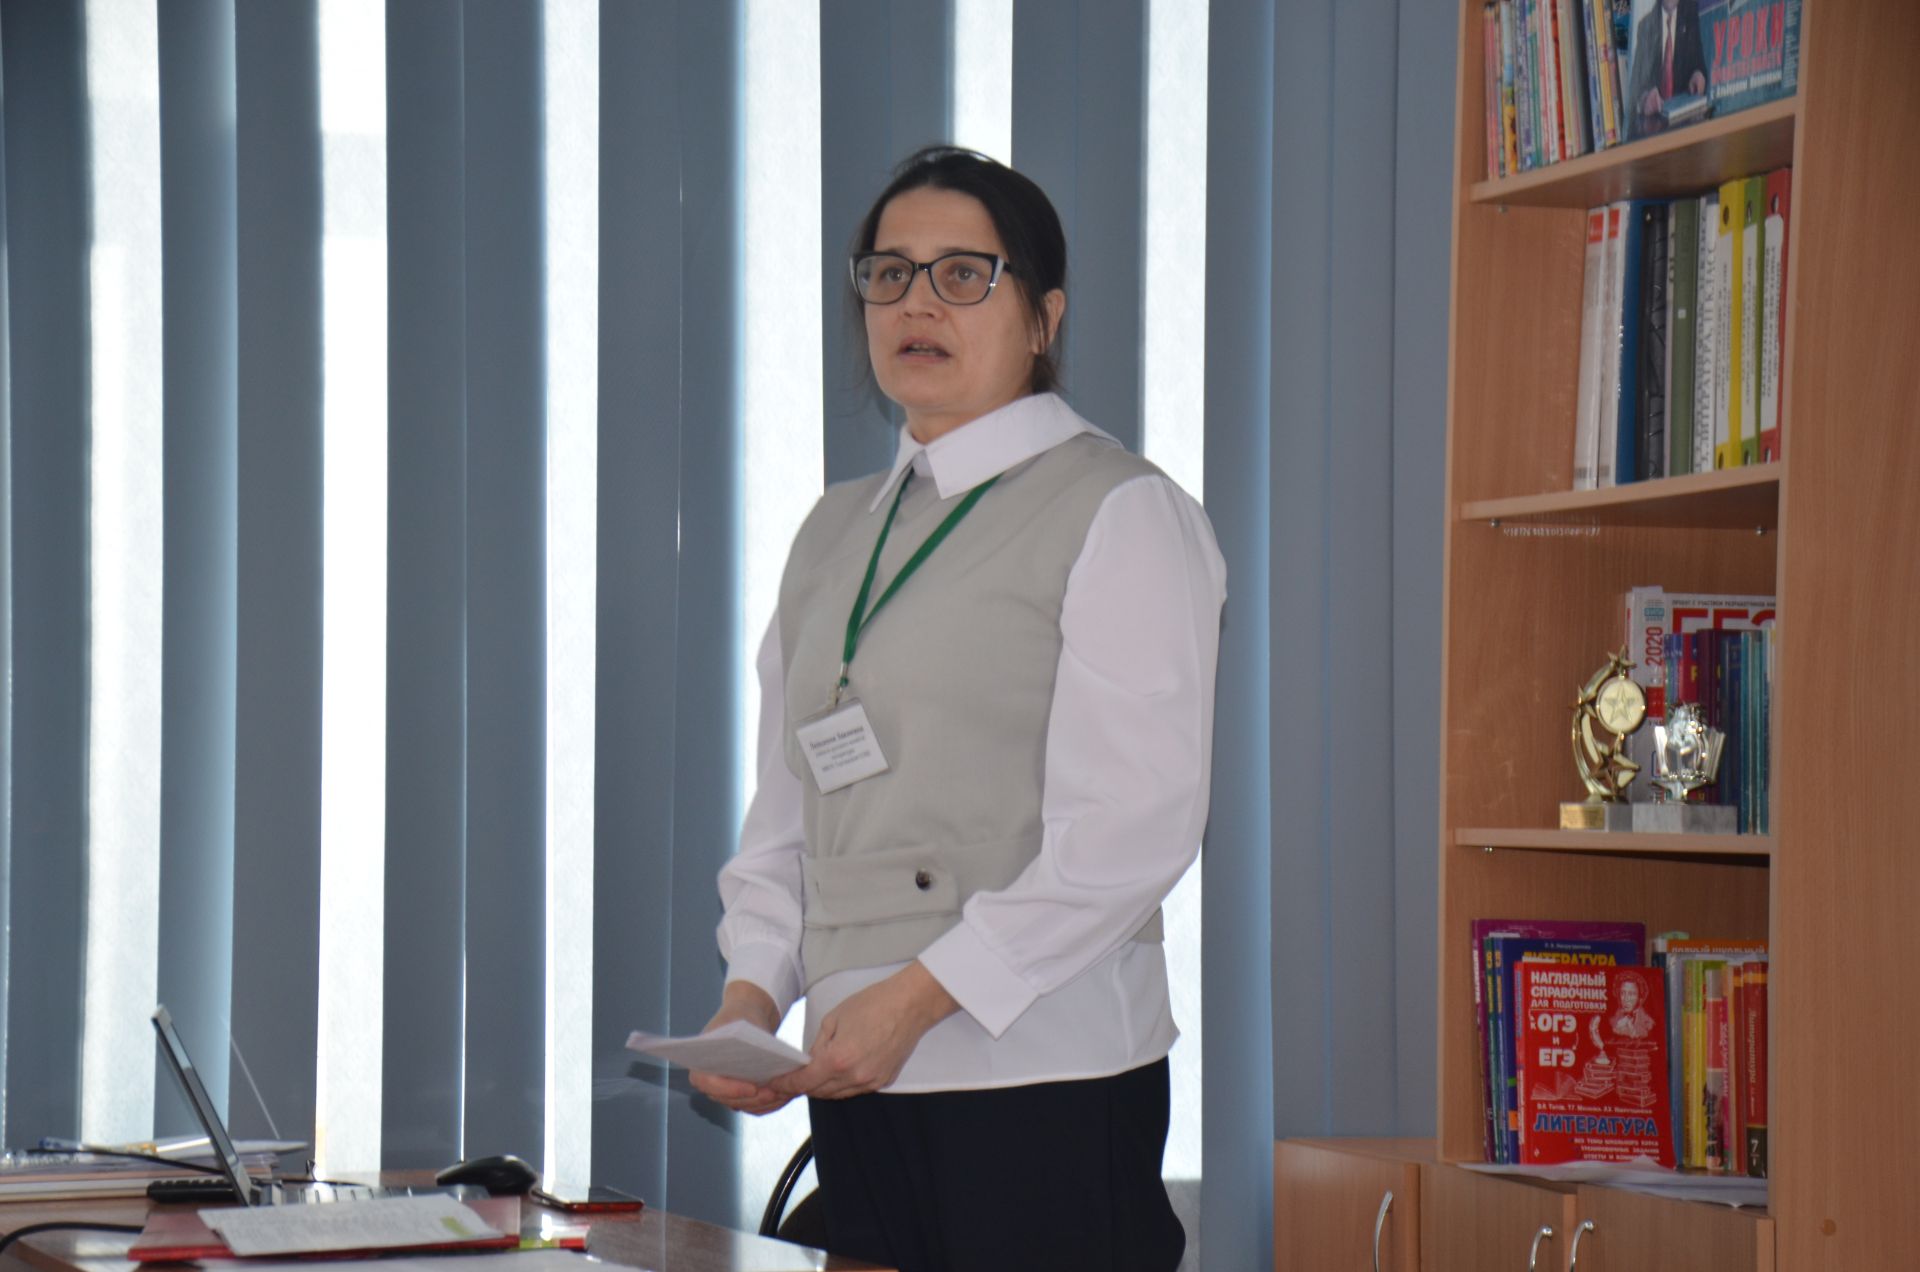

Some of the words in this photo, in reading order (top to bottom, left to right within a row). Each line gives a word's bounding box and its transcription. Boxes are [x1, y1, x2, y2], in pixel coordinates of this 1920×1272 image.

[1713, 1, 1785, 65] УРОКИ
[1645, 626, 1664, 667] 2020
[1530, 970, 1607, 987] НАГЛЯДНЫЙ
[1530, 985, 1608, 1001] СПРАВОЧНИК
[1531, 999, 1549, 1008] ДЛЯ
[1552, 999, 1607, 1010] ПОДГОТОВКИ
[1537, 1013, 1577, 1033] ОГЭ
[1538, 1047, 1576, 1068] ЕГЭ
[1534, 1113, 1658, 1136] ЛИТЕРАТУРА
[1751, 1139, 1759, 1153] 7
